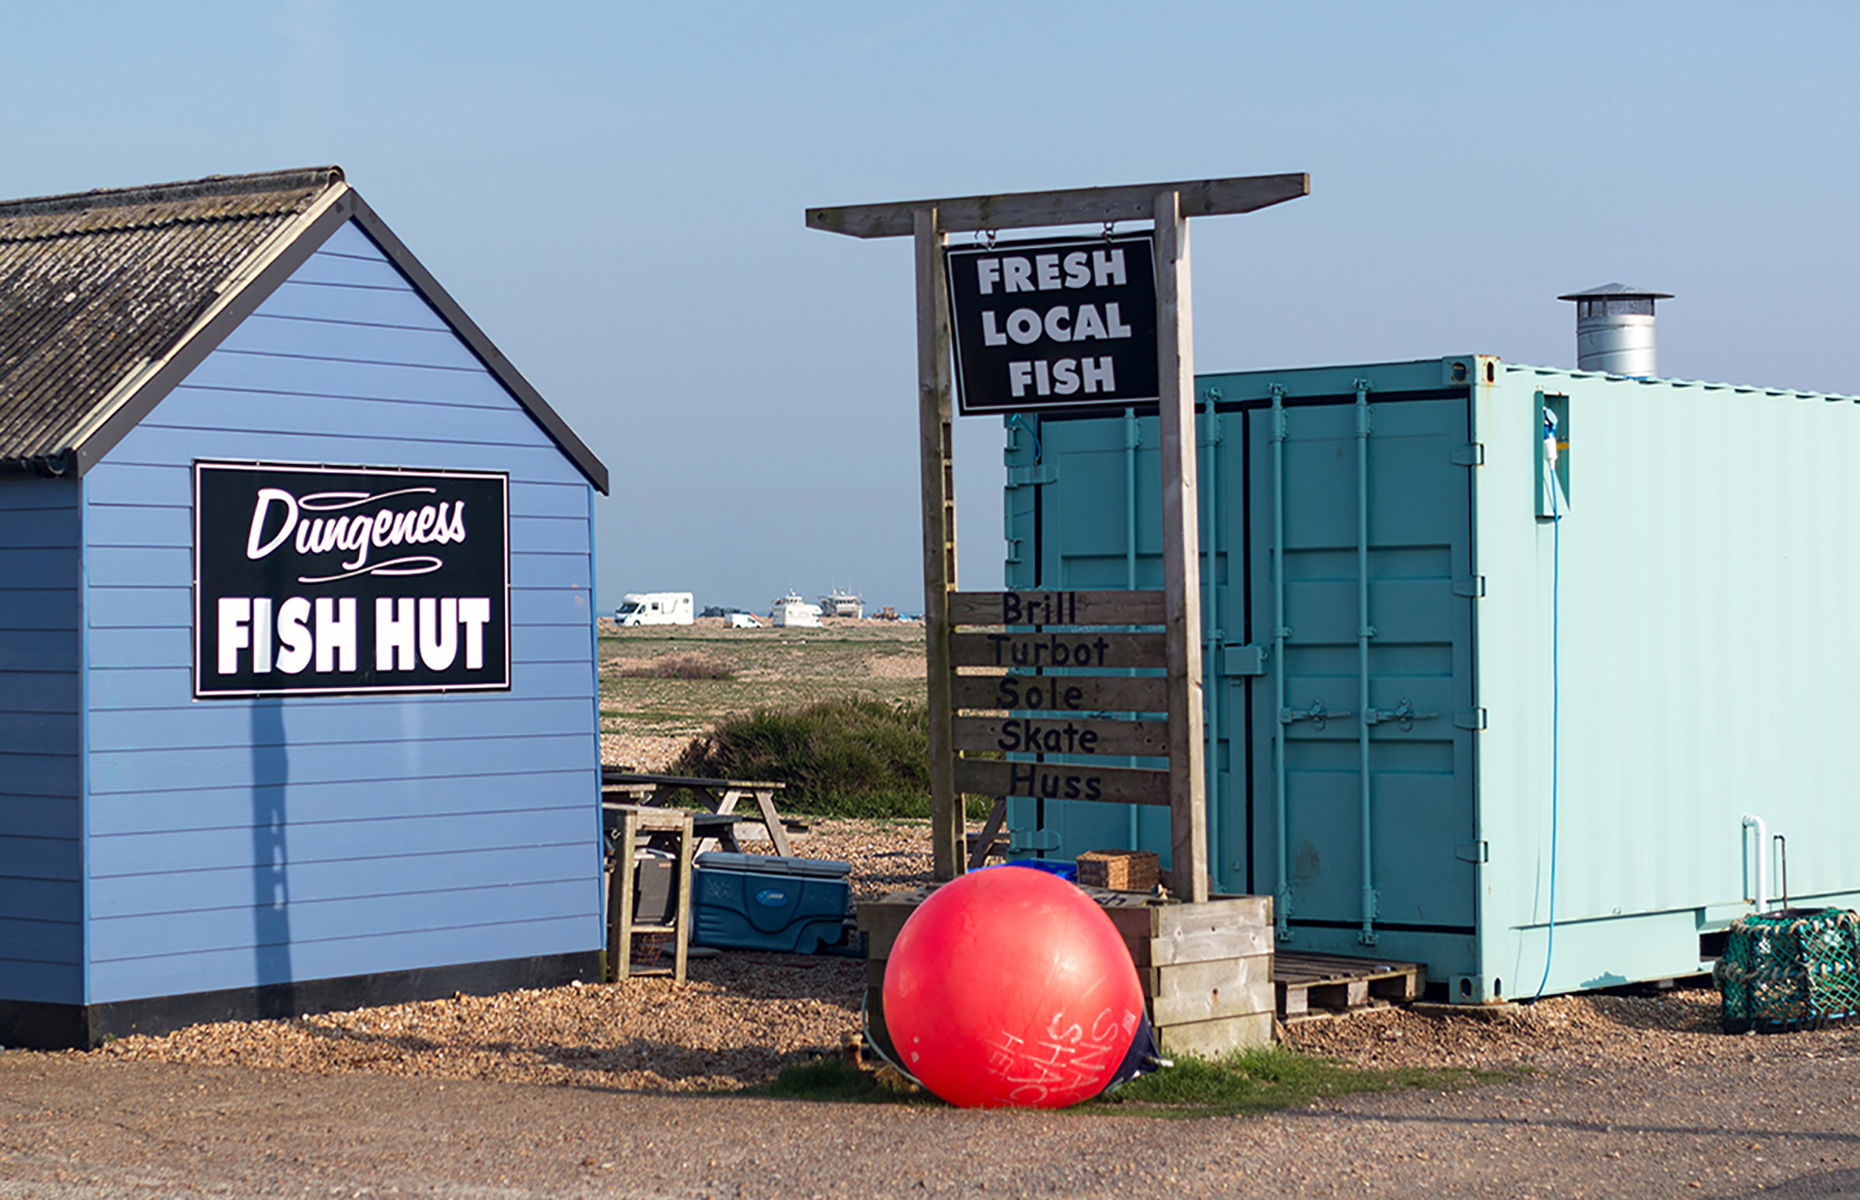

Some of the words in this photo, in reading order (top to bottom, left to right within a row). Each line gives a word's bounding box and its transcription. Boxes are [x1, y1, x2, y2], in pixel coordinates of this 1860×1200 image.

[977, 248, 1127, 295] FRESH
[982, 302, 1132, 347] LOCAL
[1008, 356, 1116, 397] FISH
[246, 487, 467, 571] Dungeness
[1002, 591, 1076, 624] Brill
[217, 596, 358, 674] FISH
[375, 597, 491, 672] HUT
[987, 633, 1110, 666] Turbot
[996, 677, 1083, 710] Sole
[997, 719, 1099, 753] Skate
[1009, 763, 1103, 800] Huss
